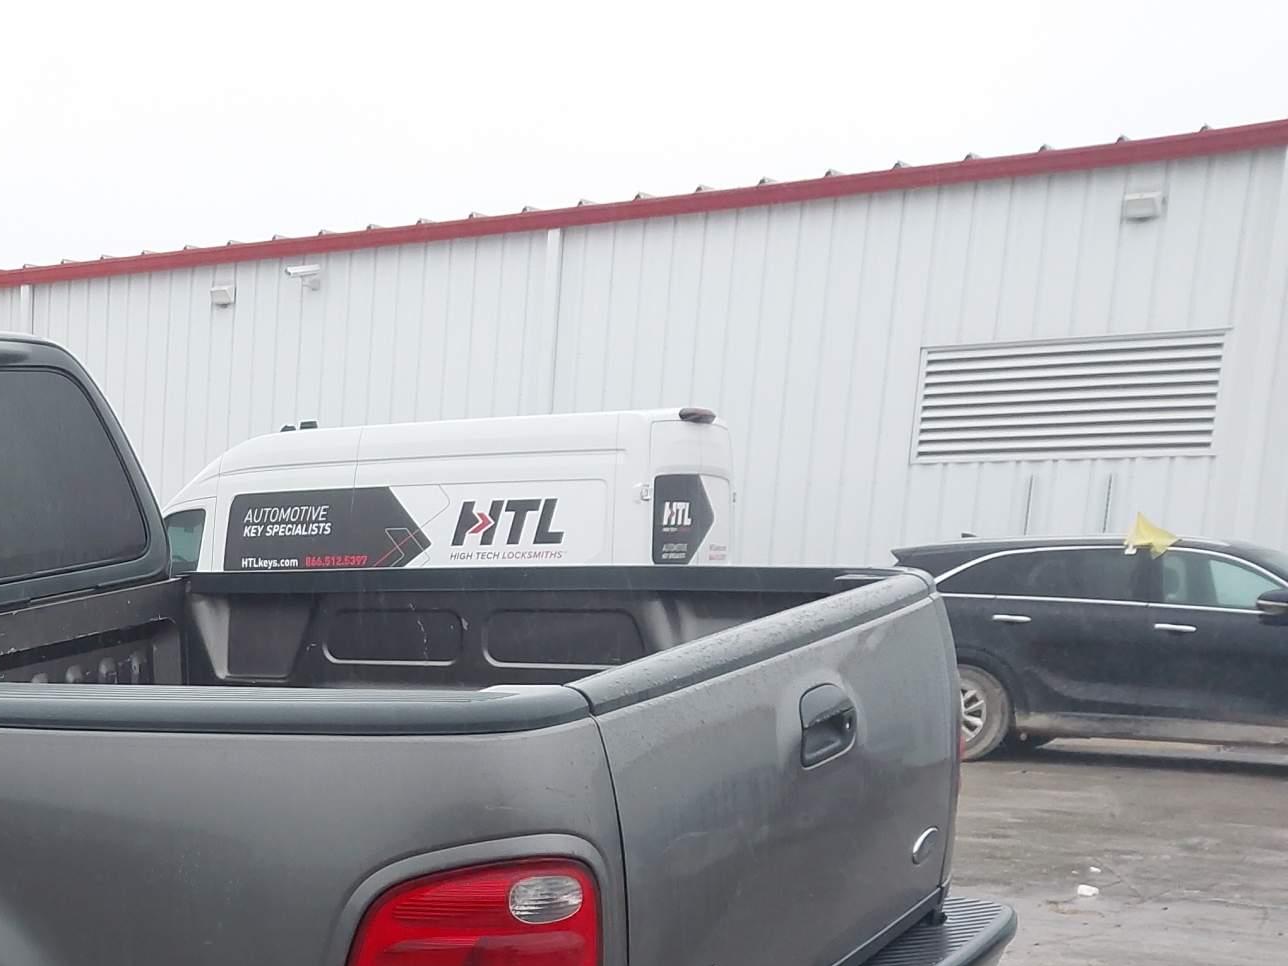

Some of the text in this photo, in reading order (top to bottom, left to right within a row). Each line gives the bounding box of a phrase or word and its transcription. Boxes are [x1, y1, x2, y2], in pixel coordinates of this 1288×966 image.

[243, 505, 329, 523] AUTOMOTIVE
[663, 501, 692, 526] HTL
[243, 522, 331, 537] KEY SPECIALISTS
[451, 498, 564, 546] HTL
[241, 557, 299, 569] HTLkeys.com
[450, 550, 563, 561] HIGH TECH LOCKSMITHS
